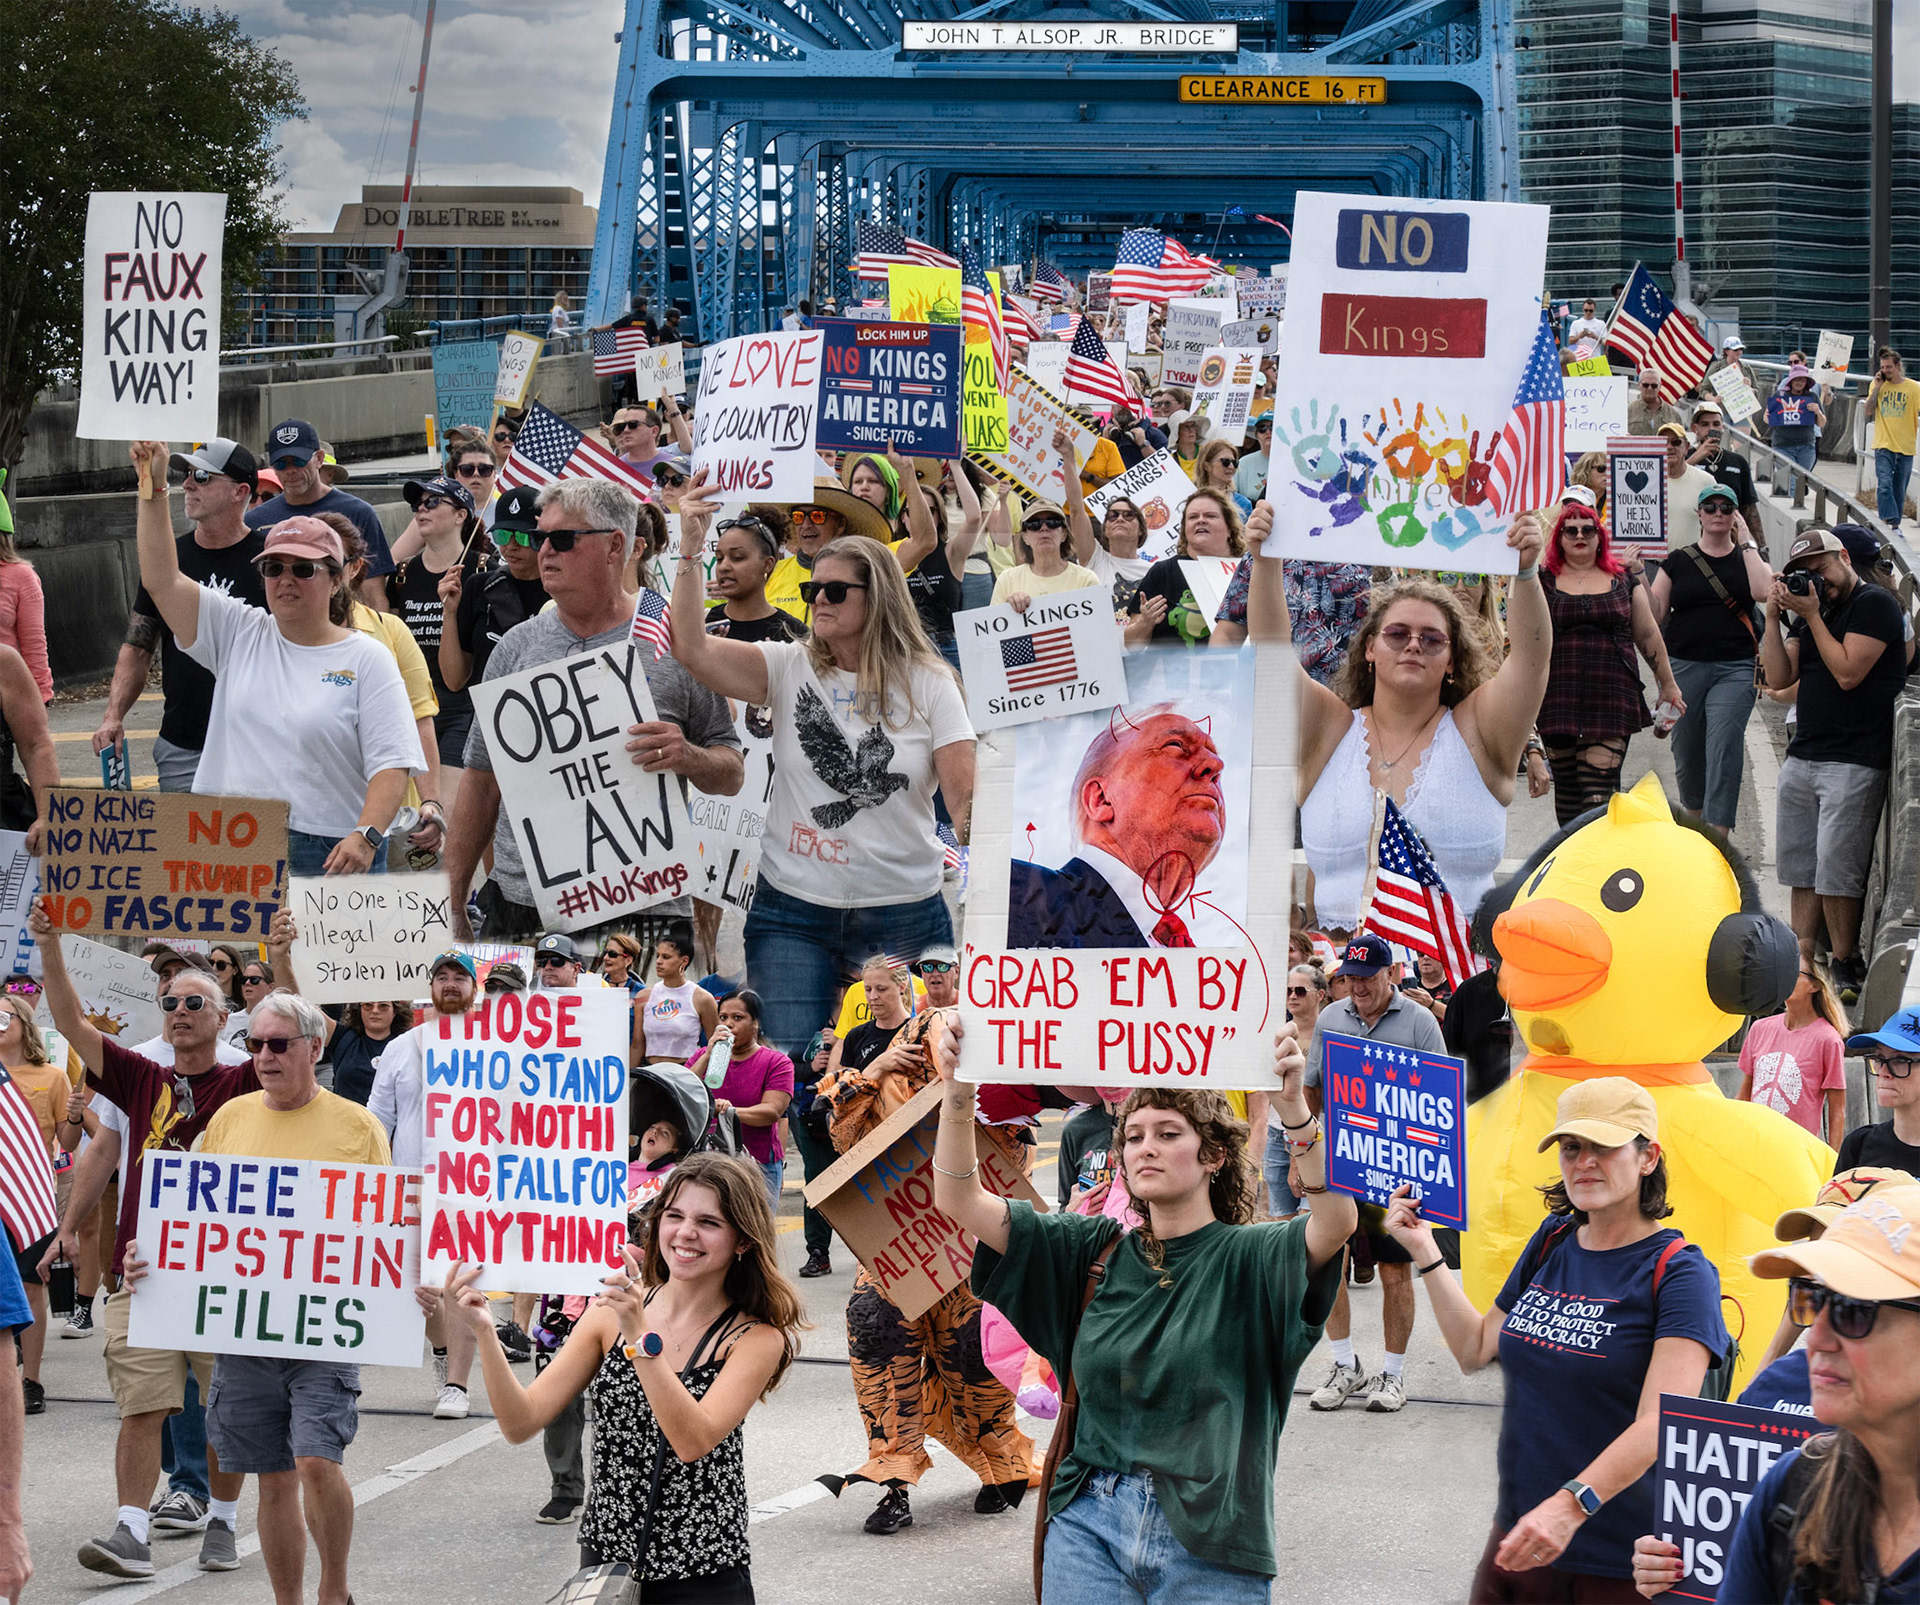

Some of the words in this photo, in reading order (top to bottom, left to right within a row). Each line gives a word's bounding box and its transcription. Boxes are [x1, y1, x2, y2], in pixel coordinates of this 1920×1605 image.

[992, 28, 1006, 44] T.
[1094, 28, 1123, 45] JR.
[1188, 81, 1310, 98] CLEARANCE
[1325, 81, 1344, 98] 16
[1358, 85, 1376, 98] FT
[134, 200, 183, 249] NO
[512, 210, 528, 218] BY
[512, 218, 560, 227] HILTON
[1359, 213, 1433, 266] NO
[103, 251, 207, 302] FAUX
[1244, 285, 1265, 293] ROOM
[1270, 284, 1285, 292] FOR
[1274, 277, 1286, 285] NO
[104, 308, 207, 356] KING
[857, 329, 887, 341] LOCK
[889, 330, 910, 340] HIM
[913, 330, 928, 340] UP
[1168, 307, 1219, 329] DEPORTATION
[1344, 302, 1449, 353] Kings
[434, 342, 491, 362] GUARANTEES
[1165, 339, 1181, 351] DUE
[435, 371, 498, 390] CONSTITUTIO
[640, 355, 654, 371] NO
[652, 361, 682, 383] KINGS!
[698, 347, 728, 401] WE
[826, 345, 860, 375] NO
[869, 348, 947, 381] KINGS
[1165, 369, 1199, 384] TYRAN
[1576, 358, 1594, 374] NO
[109, 359, 194, 405] WAY!
[878, 379, 892, 394] IN
[1195, 391, 1220, 401] RESIST
[1564, 385, 1613, 408] cracy
[712, 403, 813, 452] COUNTRY
[823, 393, 947, 429] AMERICA
[1017, 408, 1044, 440] Was
[1783, 412, 1801, 421] NO
[964, 413, 1008, 448] LIARS
[1008, 424, 1035, 450] Not
[1036, 448, 1047, 464] a
[1617, 460, 1634, 471] IN
[1635, 460, 1655, 471] YOUR
[717, 455, 774, 493] KINGS
[1087, 489, 1107, 508] NO
[1110, 450, 1169, 492] TYRANTS
[1123, 464, 1169, 499] KINGS!
[1616, 493, 1633, 505] YOU
[1634, 493, 1658, 505] KNOW
[1626, 506, 1639, 521] HE
[1640, 506, 1651, 521] IS
[1620, 521, 1656, 536] WRONG.
[405, 599, 423, 612] They
[974, 616, 1009, 637] NO
[1022, 599, 1094, 628] KINGS
[321, 672, 354, 687] Jags
[493, 643, 644, 764] OBEY
[988, 693, 1046, 715] Since
[1057, 680, 1101, 703] 1776
[549, 750, 620, 800] THE
[48, 792, 85, 824] NO
[93, 793, 156, 823] KING
[691, 796, 731, 832] CAN
[47, 827, 83, 856] NO
[89, 827, 158, 856] NAZI
[188, 809, 259, 849] NO
[522, 772, 674, 889] LAW
[46, 863, 82, 893] NO
[86, 864, 142, 891] ICE
[163, 859, 286, 900] TRUMP!
[556, 861, 689, 919] #NoKings
[42, 894, 93, 931] NO
[103, 894, 280, 936] FASCIST
[304, 886, 339, 916] No
[347, 890, 388, 911] One
[397, 889, 419, 911] is
[12, 926, 36, 975] EEP
[303, 919, 375, 954] illegal
[393, 928, 426, 943] on
[1348, 946, 1369, 961] M
[102, 955, 126, 970] So
[142, 967, 158, 984] ba
[316, 960, 385, 984] Stolen
[492, 945, 529, 970] HATE!
[107, 979, 158, 1000] introvert
[1101, 956, 1178, 1009] 'EM
[1197, 956, 1248, 1012] BY
[651, 1001, 682, 1017] Fanta
[987, 1019, 1062, 1070] THE
[1098, 1018, 1236, 1077] PUSSY"
[426, 1048, 511, 1091] WHO
[519, 1053, 626, 1104] STAND
[1332, 1072, 1367, 1110] NO
[1374, 1081, 1454, 1131] KINGS
[425, 1092, 506, 1147] FOR
[510, 1101, 614, 1152] NOTHI
[1385, 1118, 1399, 1139] IN
[1090, 1151, 1107, 1171] NO
[1335, 1128, 1455, 1189] AMERICA
[149, 1156, 299, 1218] FREE
[319, 1167, 425, 1228] THE
[883, 1156, 936, 1229] NOT
[157, 1219, 405, 1290] EPSTEIN
[427, 1208, 628, 1270] ANYTHING
[195, 1284, 367, 1349] FILES
[1511, 1300, 1530, 1316] AY
[1527, 1307, 1550, 1323] TO
[1548, 1313, 1617, 1337] PROTECT
[1521, 1289, 1550, 1307] IT'S
[1546, 1298, 1562, 1312] A
[1562, 1301, 1605, 1319] GOOD
[1507, 1315, 1604, 1350] DEMOCRACY
[1664, 1425, 1783, 1484] HATE
[1662, 1478, 1754, 1533] NOT
[1661, 1532, 1725, 1587] US
